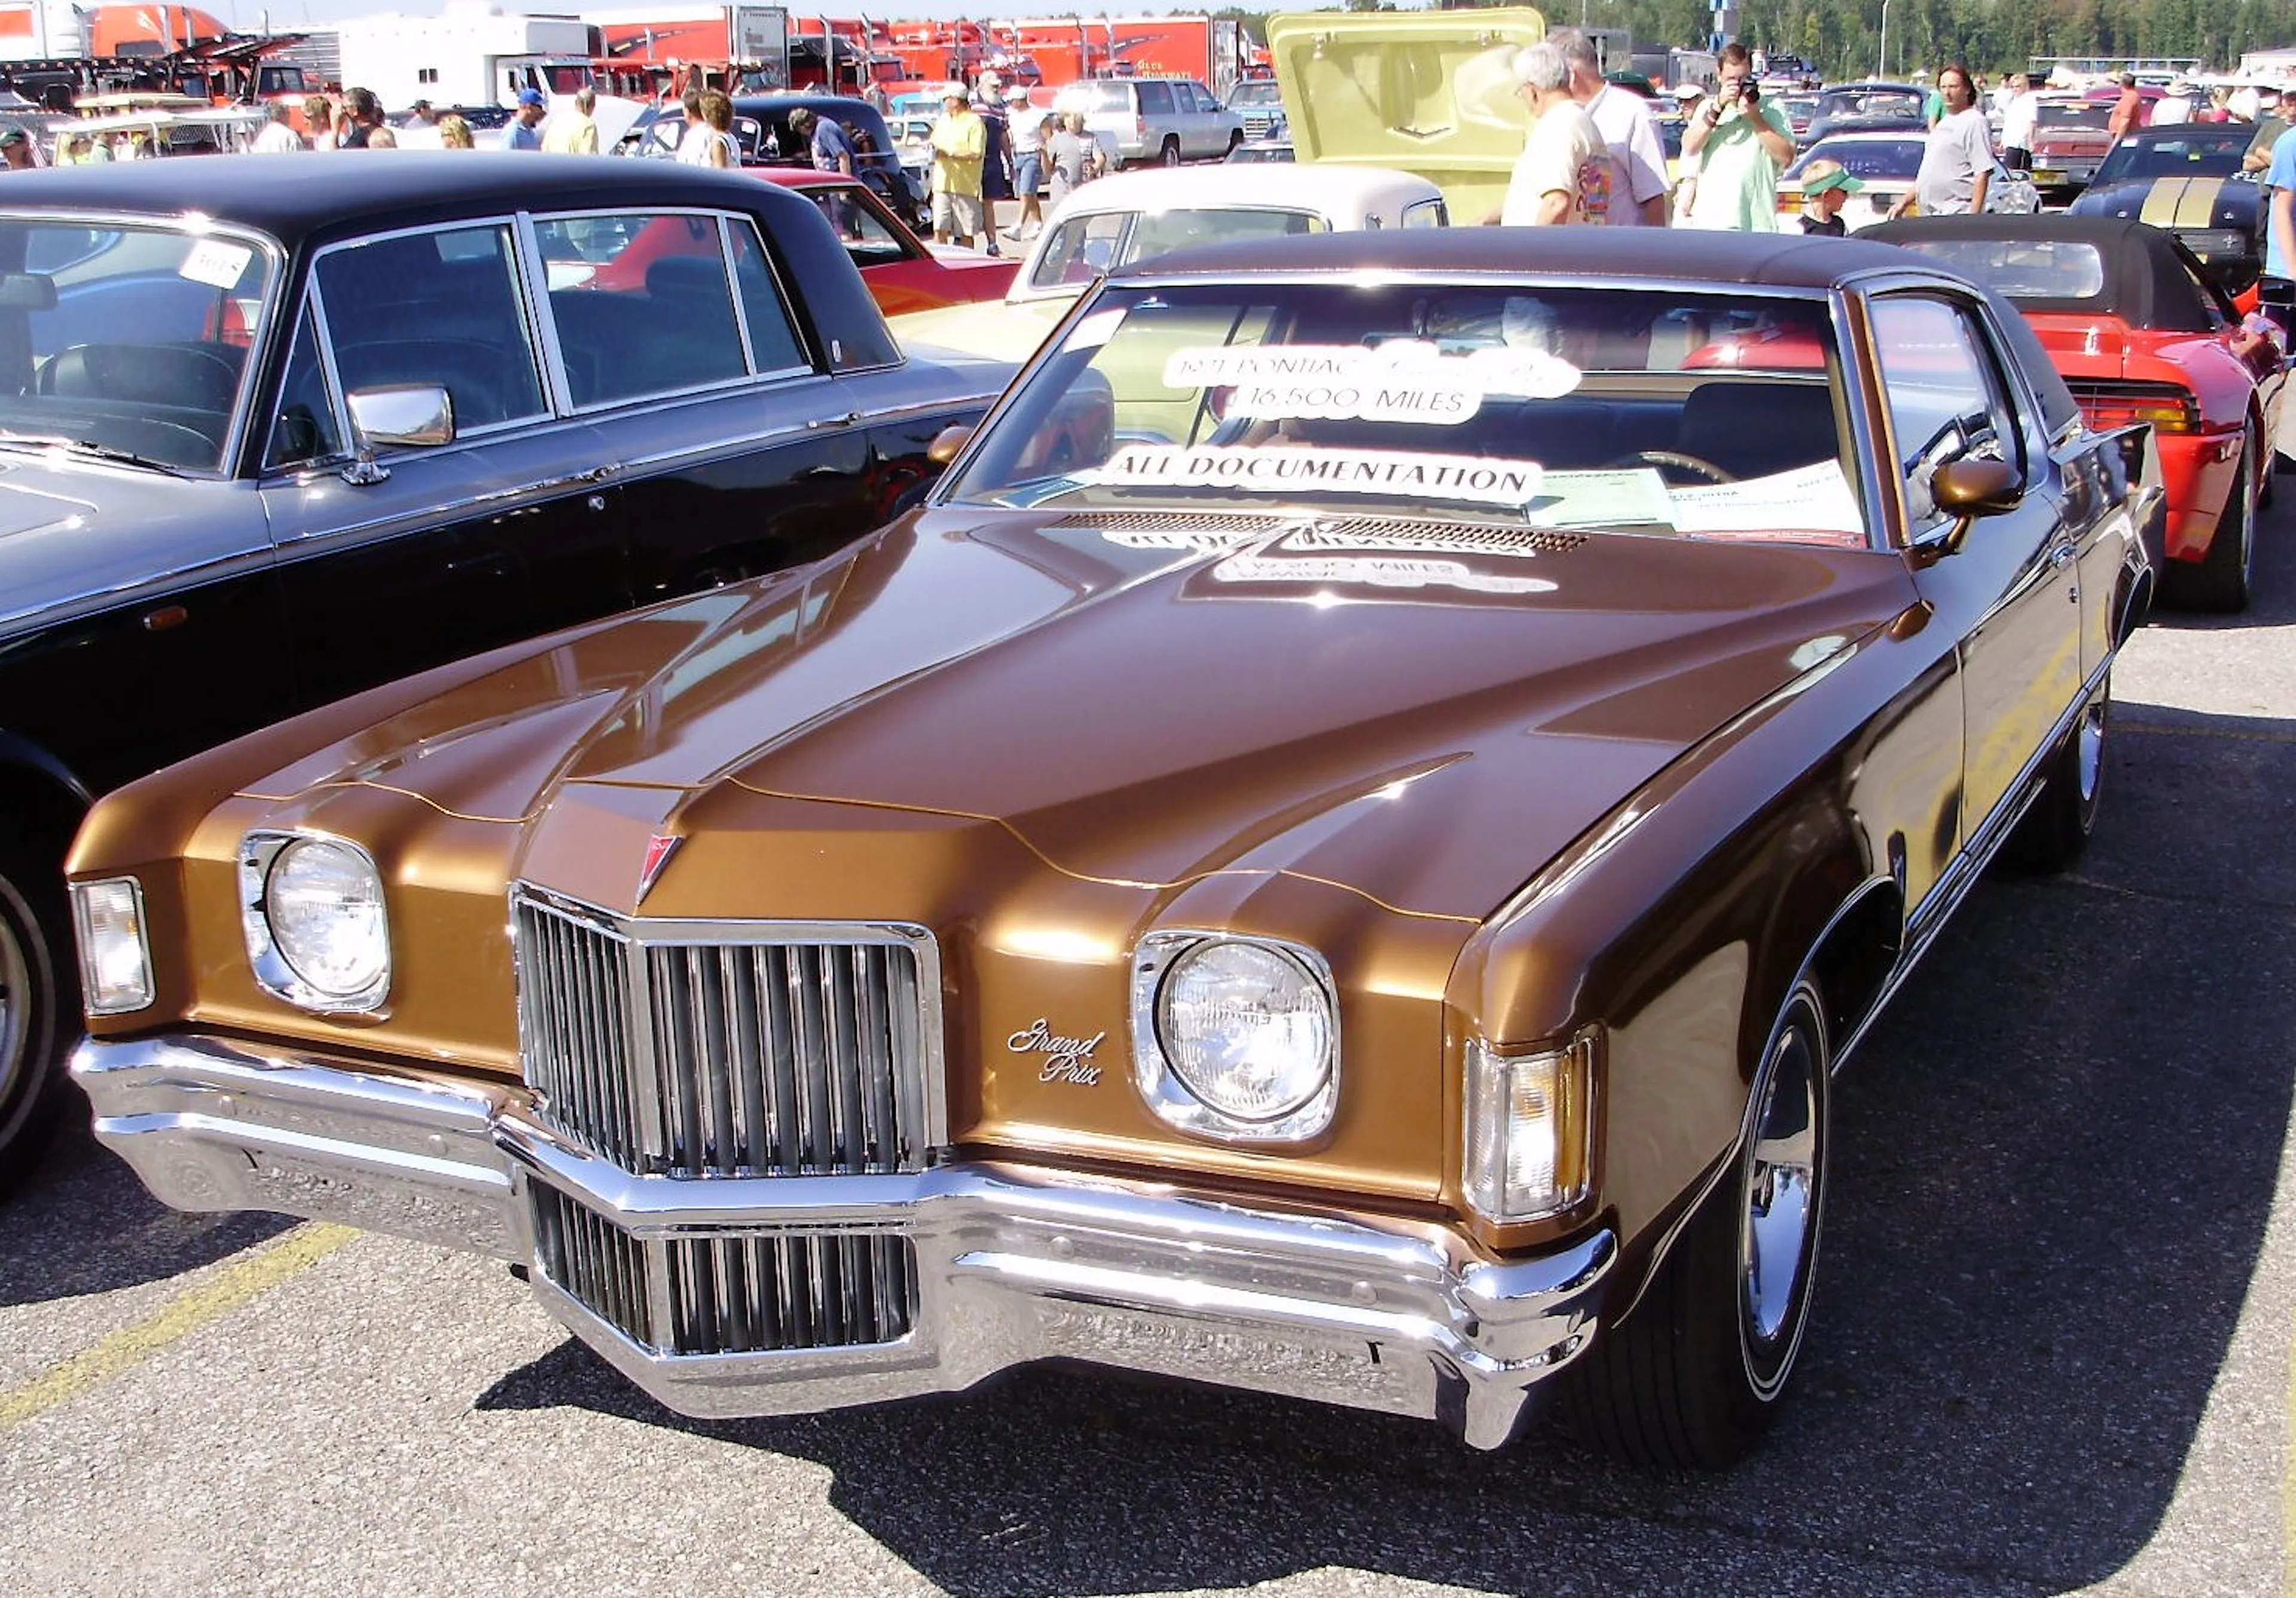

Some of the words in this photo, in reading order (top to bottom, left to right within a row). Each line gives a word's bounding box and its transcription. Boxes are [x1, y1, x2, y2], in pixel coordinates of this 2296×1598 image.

[1376, 389, 1464, 412] MILES
[1116, 456, 1173, 474] ALL
[1188, 457, 1527, 493] DOCUMENTATION
[1007, 1017, 1106, 1058] Grand
[1037, 1051, 1103, 1086] Prix
